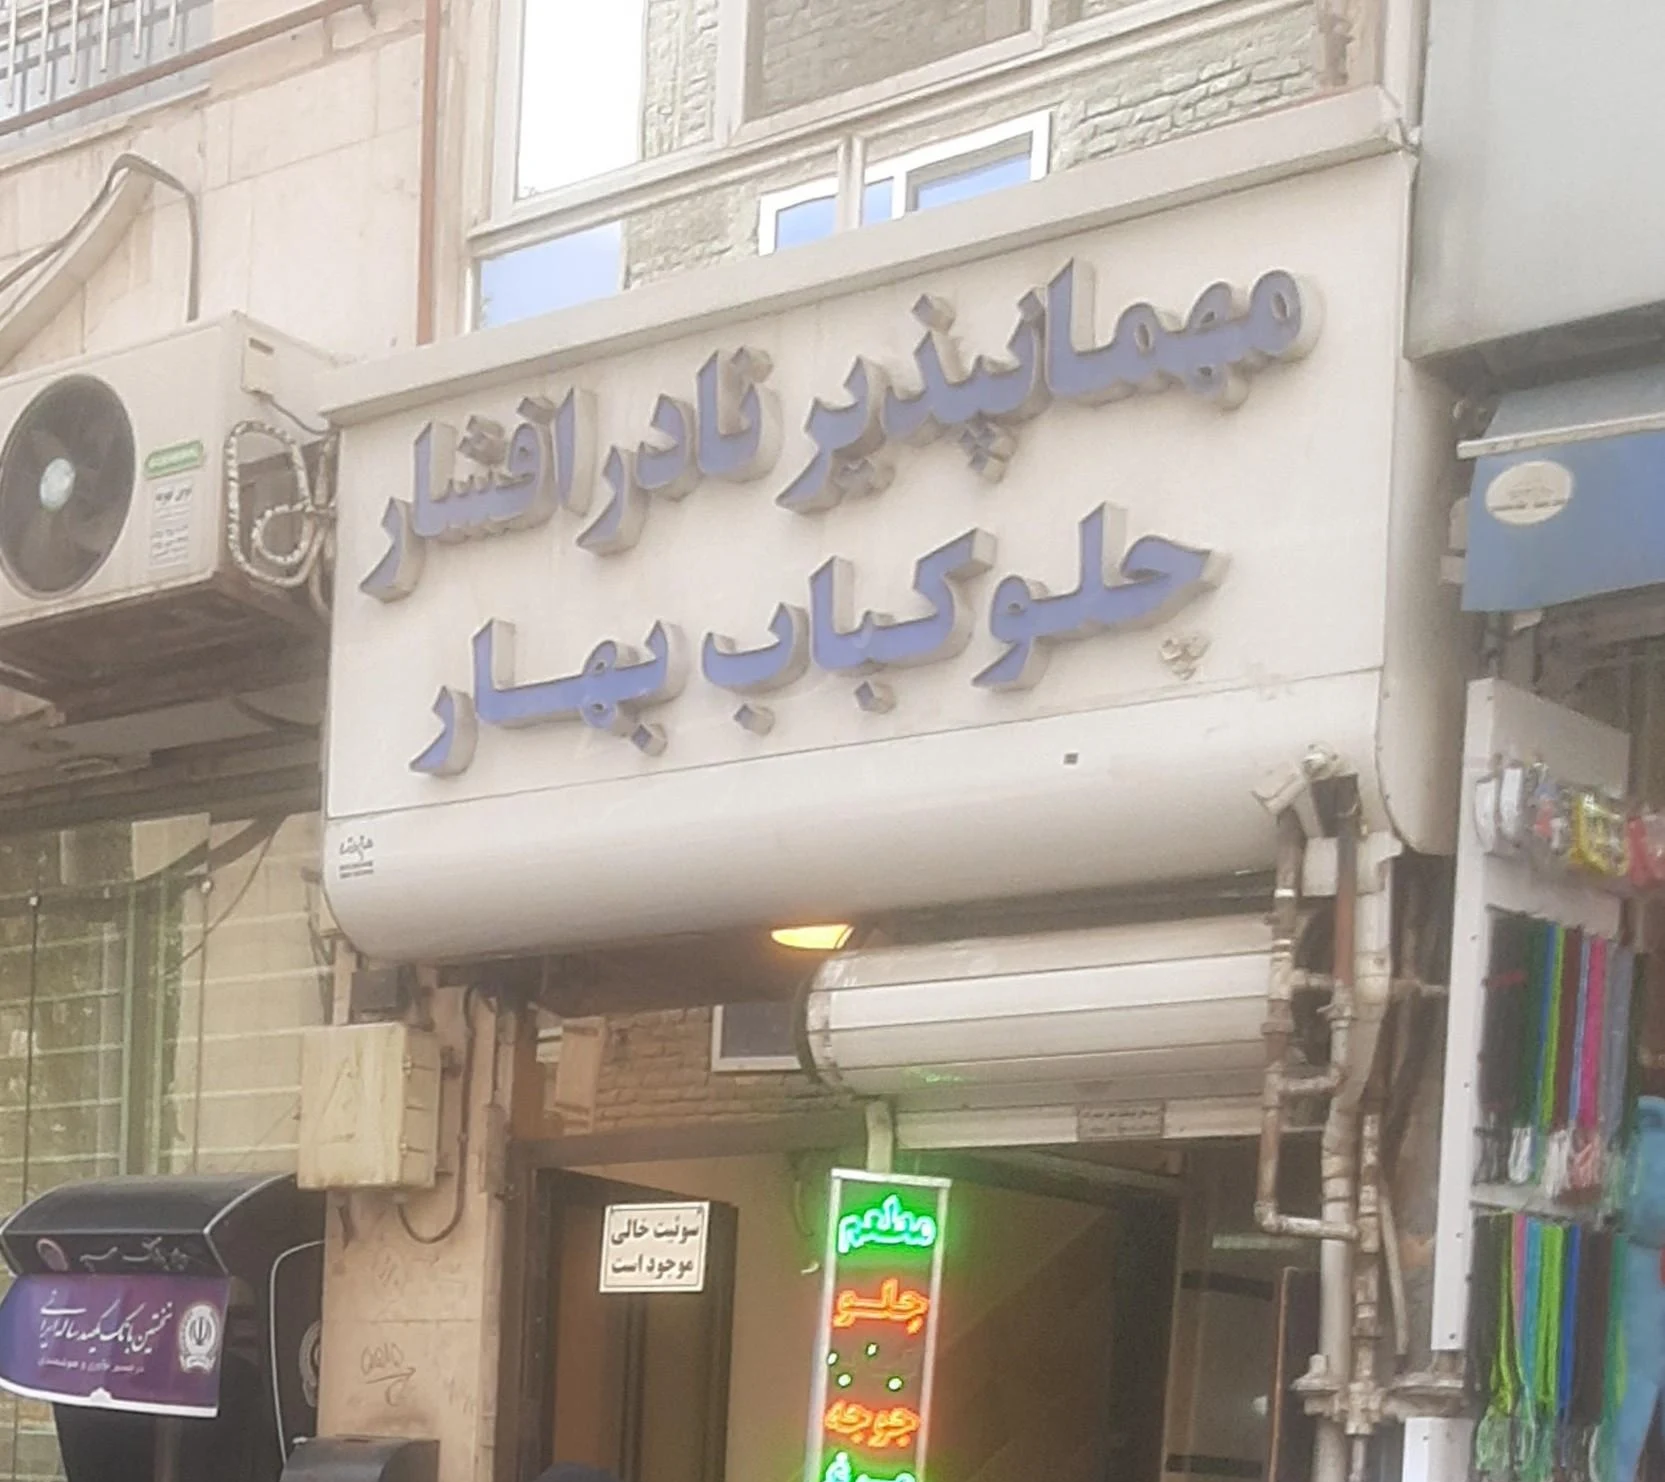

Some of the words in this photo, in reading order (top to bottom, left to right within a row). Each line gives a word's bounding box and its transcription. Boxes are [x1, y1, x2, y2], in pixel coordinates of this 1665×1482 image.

[577, 345, 778, 555] نادر
[358, 386, 597, 602] افشار
[408, 617, 684, 777] بهار
[610, 1217, 650, 1246] خالی
[611, 1254, 644, 1275] است
[647, 1257, 693, 1280] موجود
[99, 1302, 148, 1354] بانک
[823, 1399, 921, 1448] جوجه
